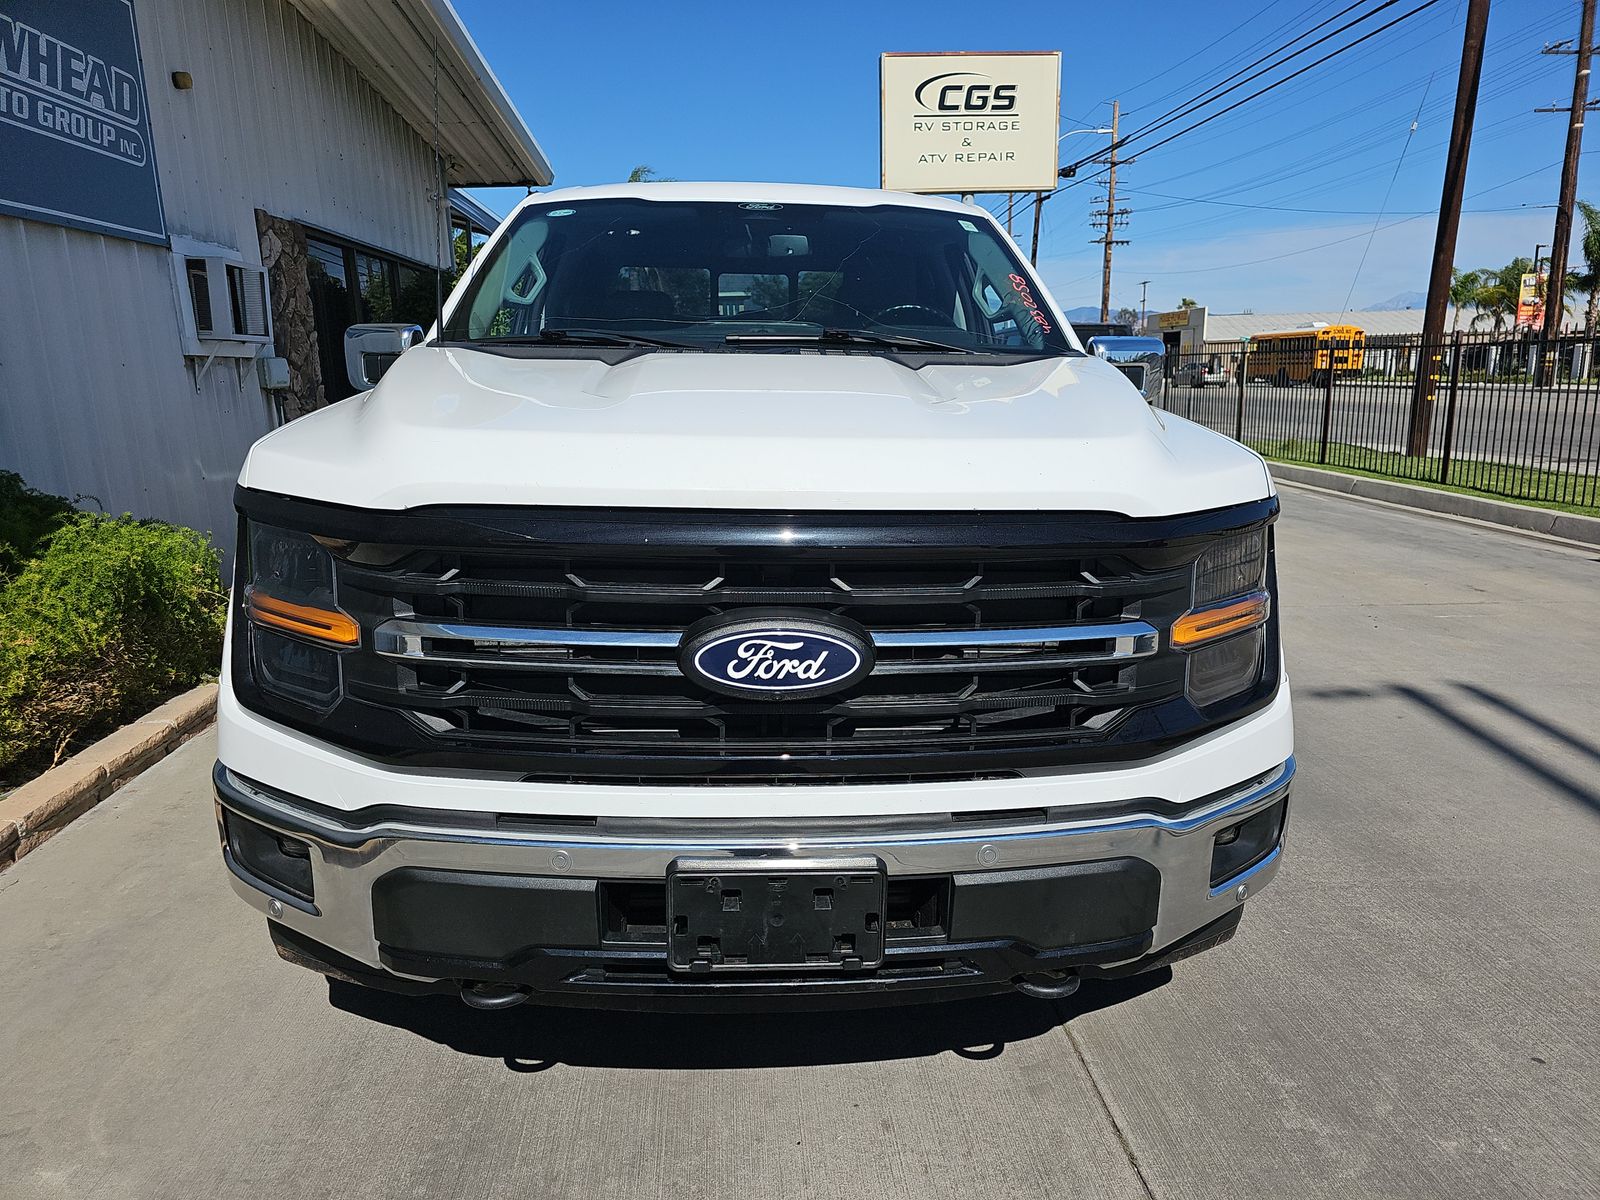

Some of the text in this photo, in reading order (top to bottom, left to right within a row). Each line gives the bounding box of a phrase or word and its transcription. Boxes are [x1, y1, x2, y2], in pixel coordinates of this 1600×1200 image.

[938, 84, 1018, 112] CGS
[38, 100, 116, 148] GROUP
[120, 138, 142, 159] INC.
[913, 120, 1021, 132] RV STORAGE
[961, 137, 972, 147] &
[918, 151, 1016, 164] ATV REPAIR
[726, 639, 829, 680] Ford
